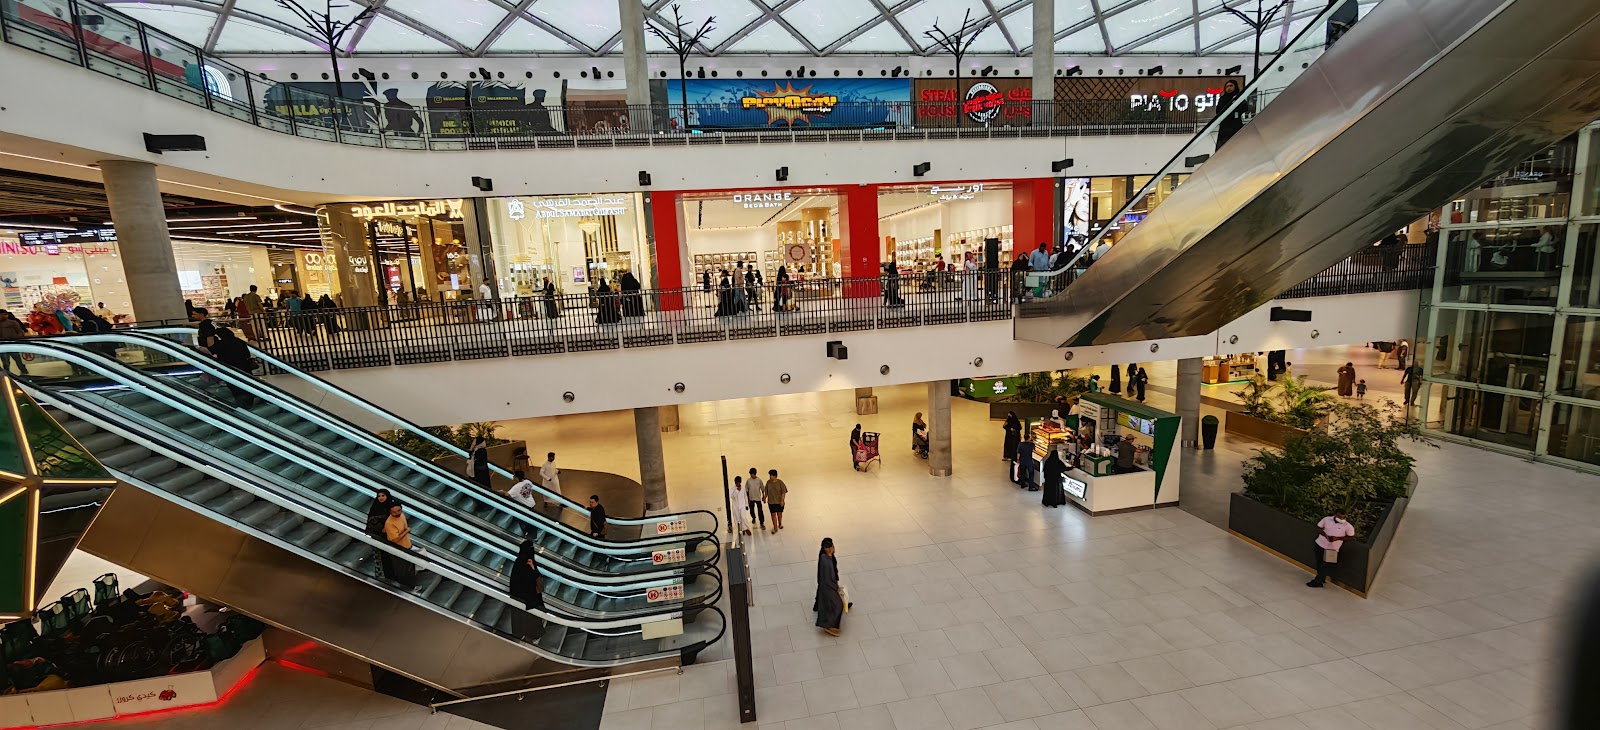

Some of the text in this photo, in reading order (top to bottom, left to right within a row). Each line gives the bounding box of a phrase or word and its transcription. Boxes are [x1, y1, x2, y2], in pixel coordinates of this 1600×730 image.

[921, 89, 957, 101] STEA
[573, 197, 602, 208] الصمد
[604, 197, 625, 206] عبد
[733, 192, 792, 203] ORANGE
[351, 201, 447, 221] الماجد للعود
[84, 245, 110, 257] ميني
